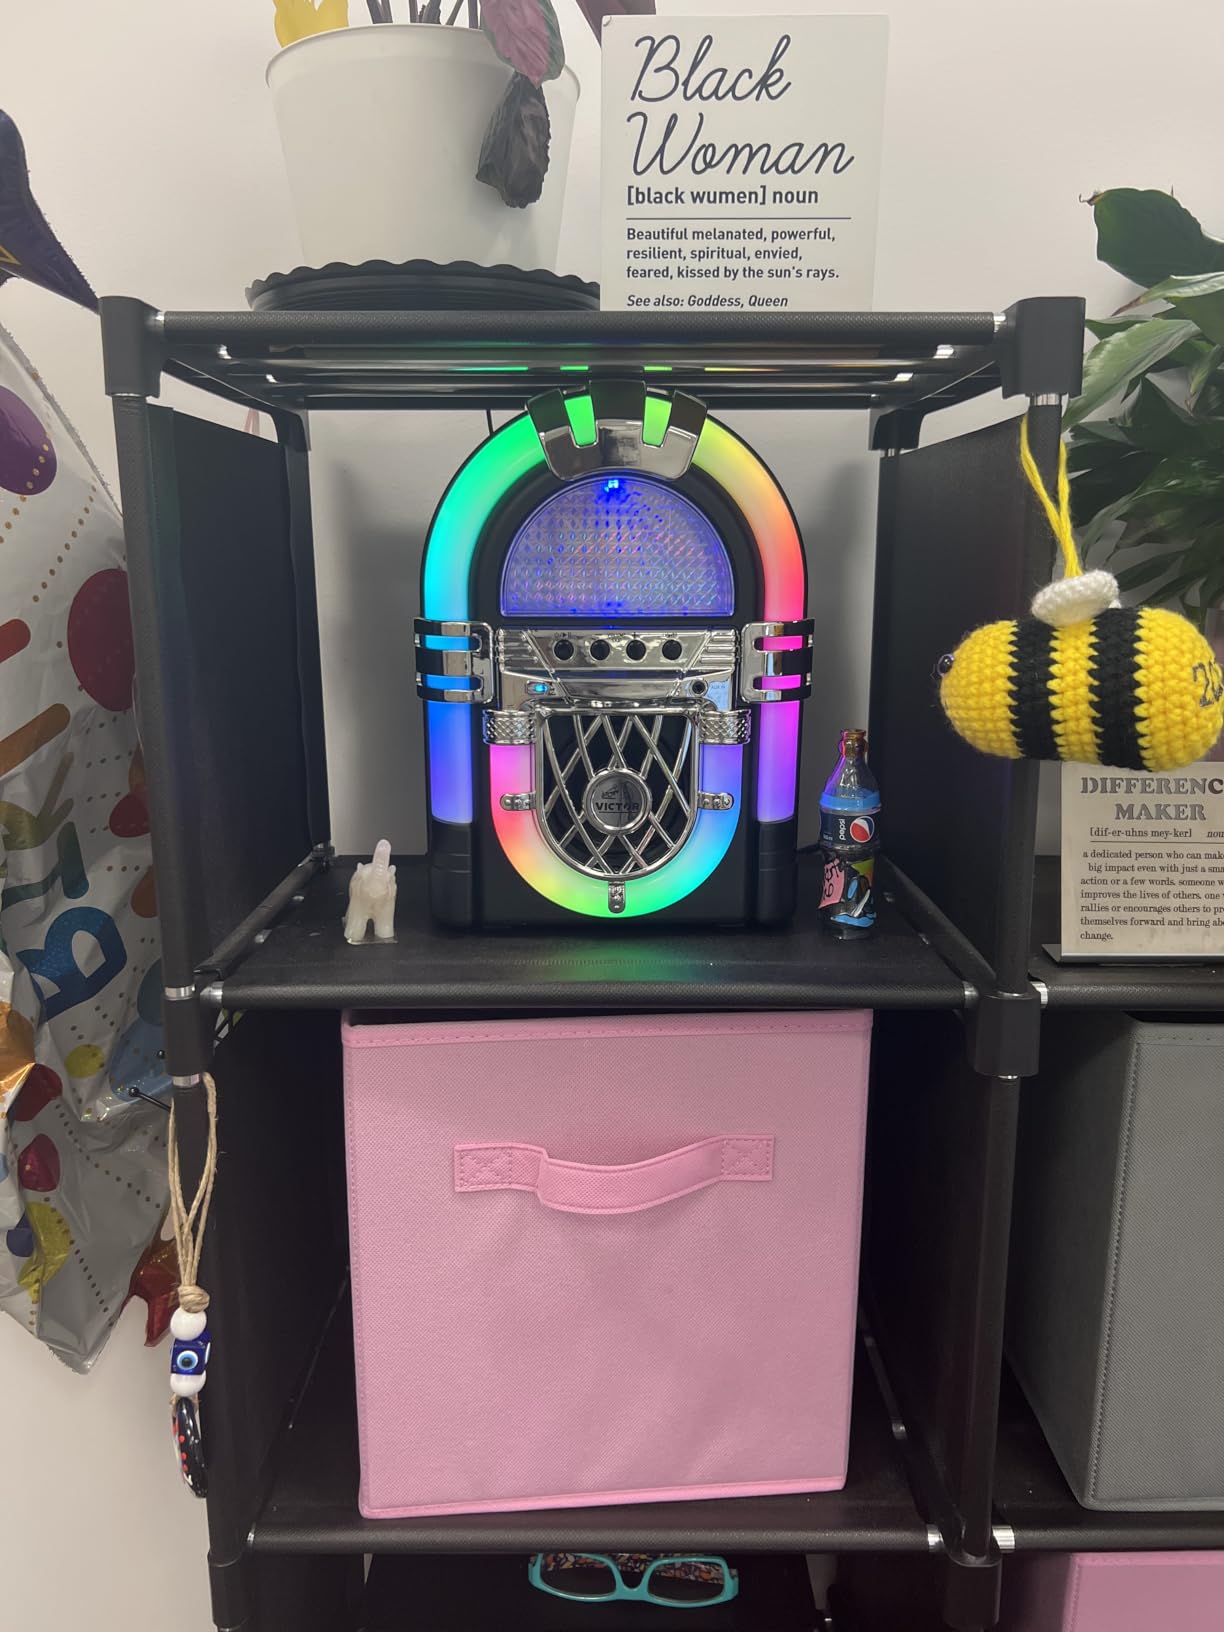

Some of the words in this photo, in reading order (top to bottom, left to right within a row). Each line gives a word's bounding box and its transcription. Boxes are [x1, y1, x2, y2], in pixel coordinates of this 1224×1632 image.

[630, 34, 792, 103] Black
[626, 111, 855, 176] Woman
[627, 185, 685, 206] [black
[690, 184, 767, 206] wumen]
[772, 190, 819, 204] noun
[626, 227, 689, 241] Beautiful
[691, 227, 767, 243] melanated,
[771, 227, 836, 244] powerful,
[626, 246, 687, 262] resilient,
[690, 246, 751, 263] spiritual,
[754, 246, 803, 262] envied,
[626, 265, 674, 281] feared,
[677, 265, 720, 279] kissed
[723, 265, 740, 281] by
[742, 265, 764, 279] the
[767, 266, 803, 279] sun's
[806, 268, 840, 282] rays.
[626, 294, 651, 308] See
[653, 294, 685, 308] also:
[687, 294, 745, 310] Goddess,
[748, 294, 789, 308] Queen
[1080, 776, 1224, 796] DIFFERENC
[595, 802, 640, 811] VICTOR
[1115, 803, 1207, 822] MAKER
[838, 818, 847, 841] pepsi
[1082, 851, 1089, 859] a
[1090, 848, 1133, 859] dedicated
[1134, 851, 1164, 861] person
[1165, 850, 1184, 860] who
[1186, 852, 1202, 860] can
[1088, 862, 1103, 874] big
[1104, 862, 1136, 875] impact
[1136, 865, 1157, 873] even
[1158, 863, 1180, 873] with
[1180, 863, 1199, 875] just
[1080, 876, 1109, 886] action
[1110, 878, 1121, 886] or
[1122, 878, 1129, 886] a
[1130, 876, 1146, 886] few
[1178, 879, 1216, 887] someone
[1080, 889, 1121, 900] improves
[1122, 889, 1137, 899] the
[1139, 889, 1160, 900] lives
[1161, 889, 1172, 900] of
[1080, 902, 1110, 912] rallies
[1111, 905, 1121, 913] or
[1122, 905, 1172, 915] encourages
[1173, 903, 1201, 913] others
[1202, 904, 1212, 913] to
[1080, 915, 1128, 926] themselves
[1129, 916, 1166, 926] forward
[1167, 917, 1184, 927] and
[1186, 917, 1211, 929] bring
